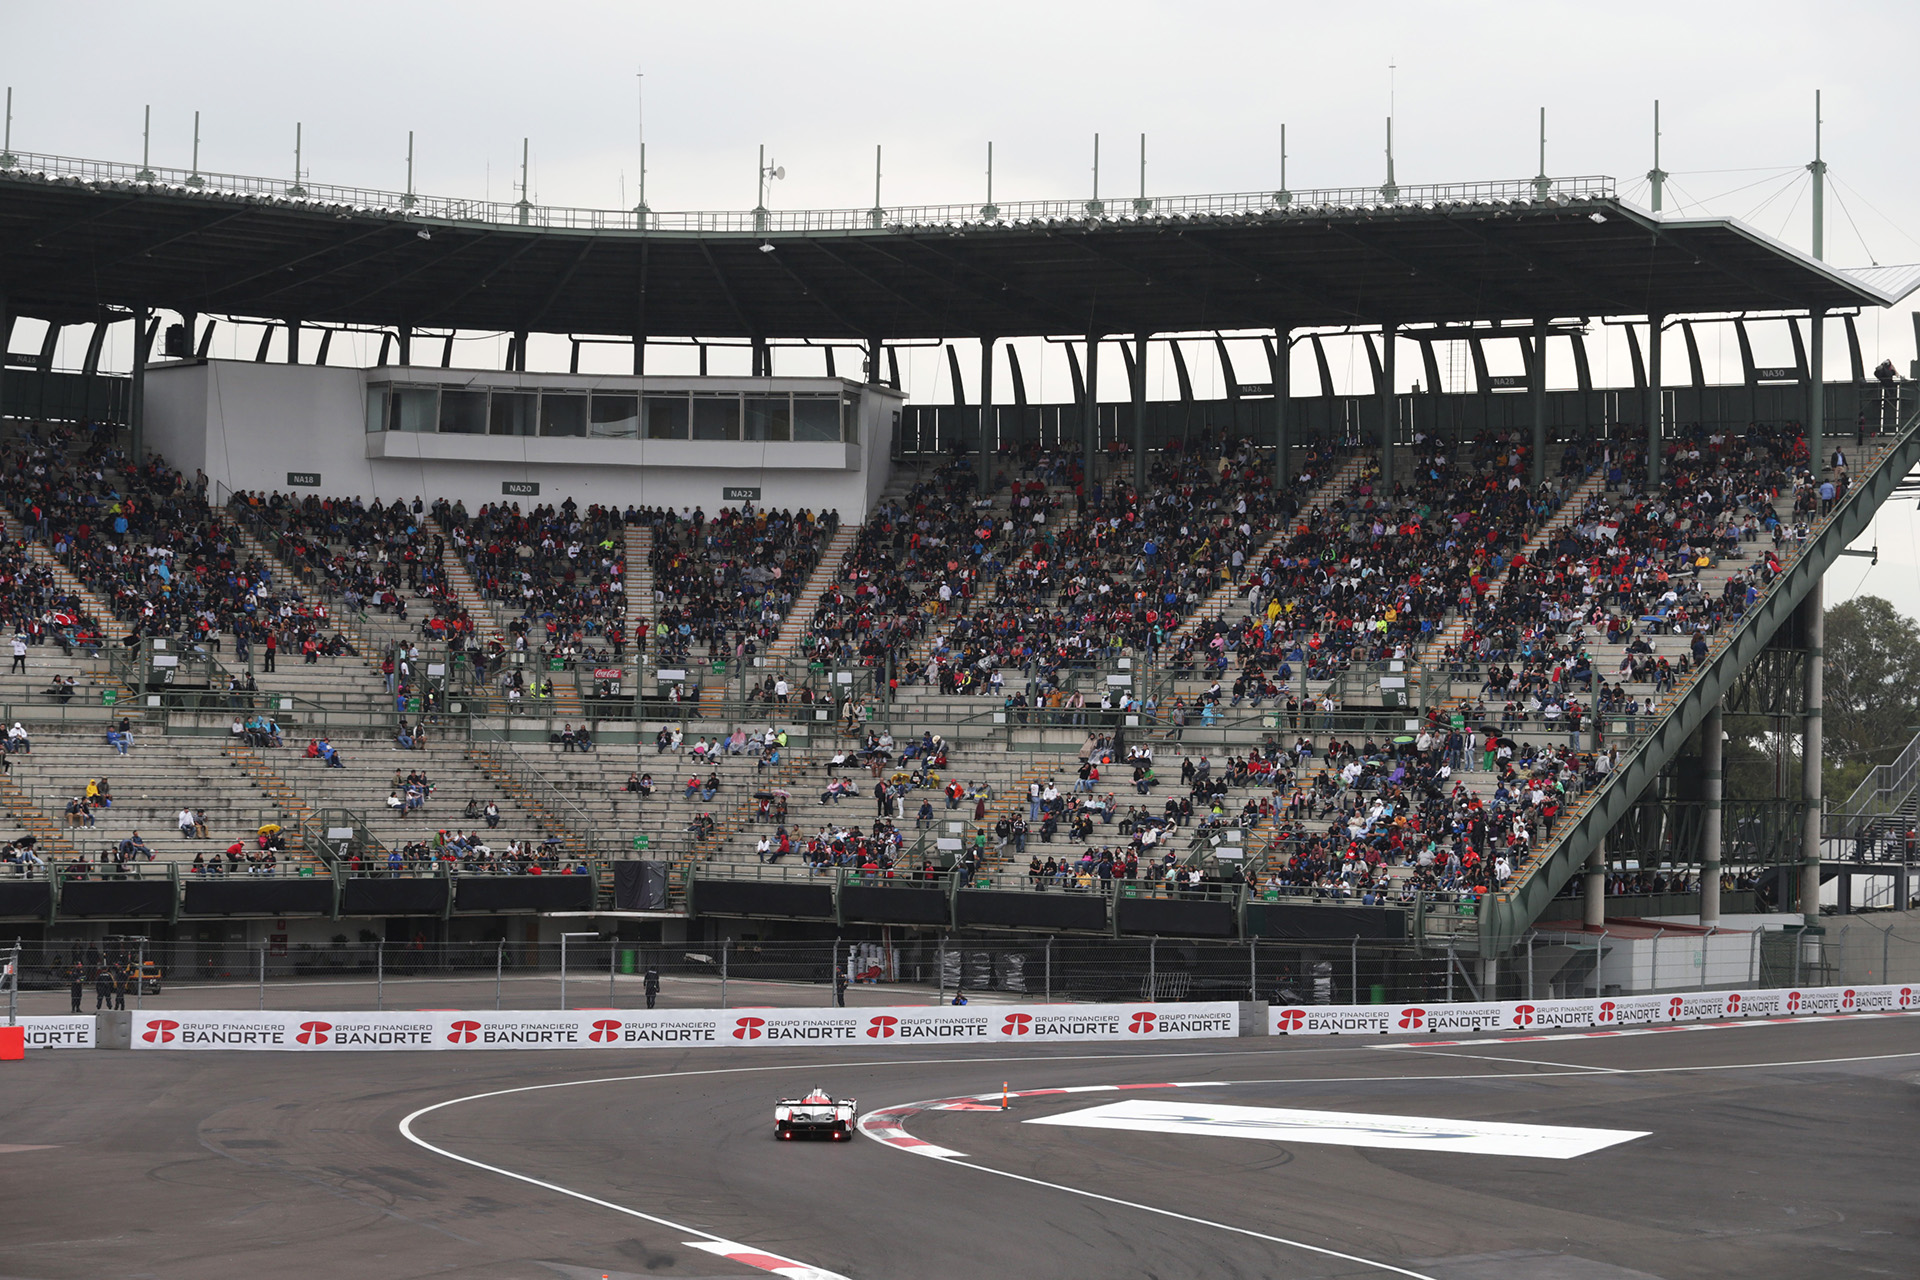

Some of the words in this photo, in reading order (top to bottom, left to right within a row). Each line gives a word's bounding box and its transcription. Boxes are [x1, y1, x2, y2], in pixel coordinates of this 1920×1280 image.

[294, 476, 314, 484] NA18
[509, 484, 532, 492] NA20
[730, 490, 753, 498] NA22
[1741, 1001, 1779, 1012] BANORTE
[1802, 999, 1838, 1010] BANORTE
[1856, 996, 1892, 1007] BANORTE
[1617, 1008, 1660, 1020] BANORTE
[1684, 1004, 1722, 1016] BANORTE
[1428, 1016, 1500, 1028] BANORTE
[1537, 1012, 1593, 1024] BANORTE
[1035, 1022, 1118, 1034] BANORTE
[1159, 1020, 1230, 1032] BANORTE
[1308, 1019, 1388, 1030] BANORTE
[484, 1032, 578, 1043] BANORTE
[625, 1030, 715, 1042] BANORTE
[768, 1028, 856, 1039] BANORTE
[900, 1025, 987, 1038] BANORTE
[24, 1032, 88, 1044] NORTE
[182, 1032, 284, 1044] BANORTE
[335, 1032, 432, 1044] BANORTE
